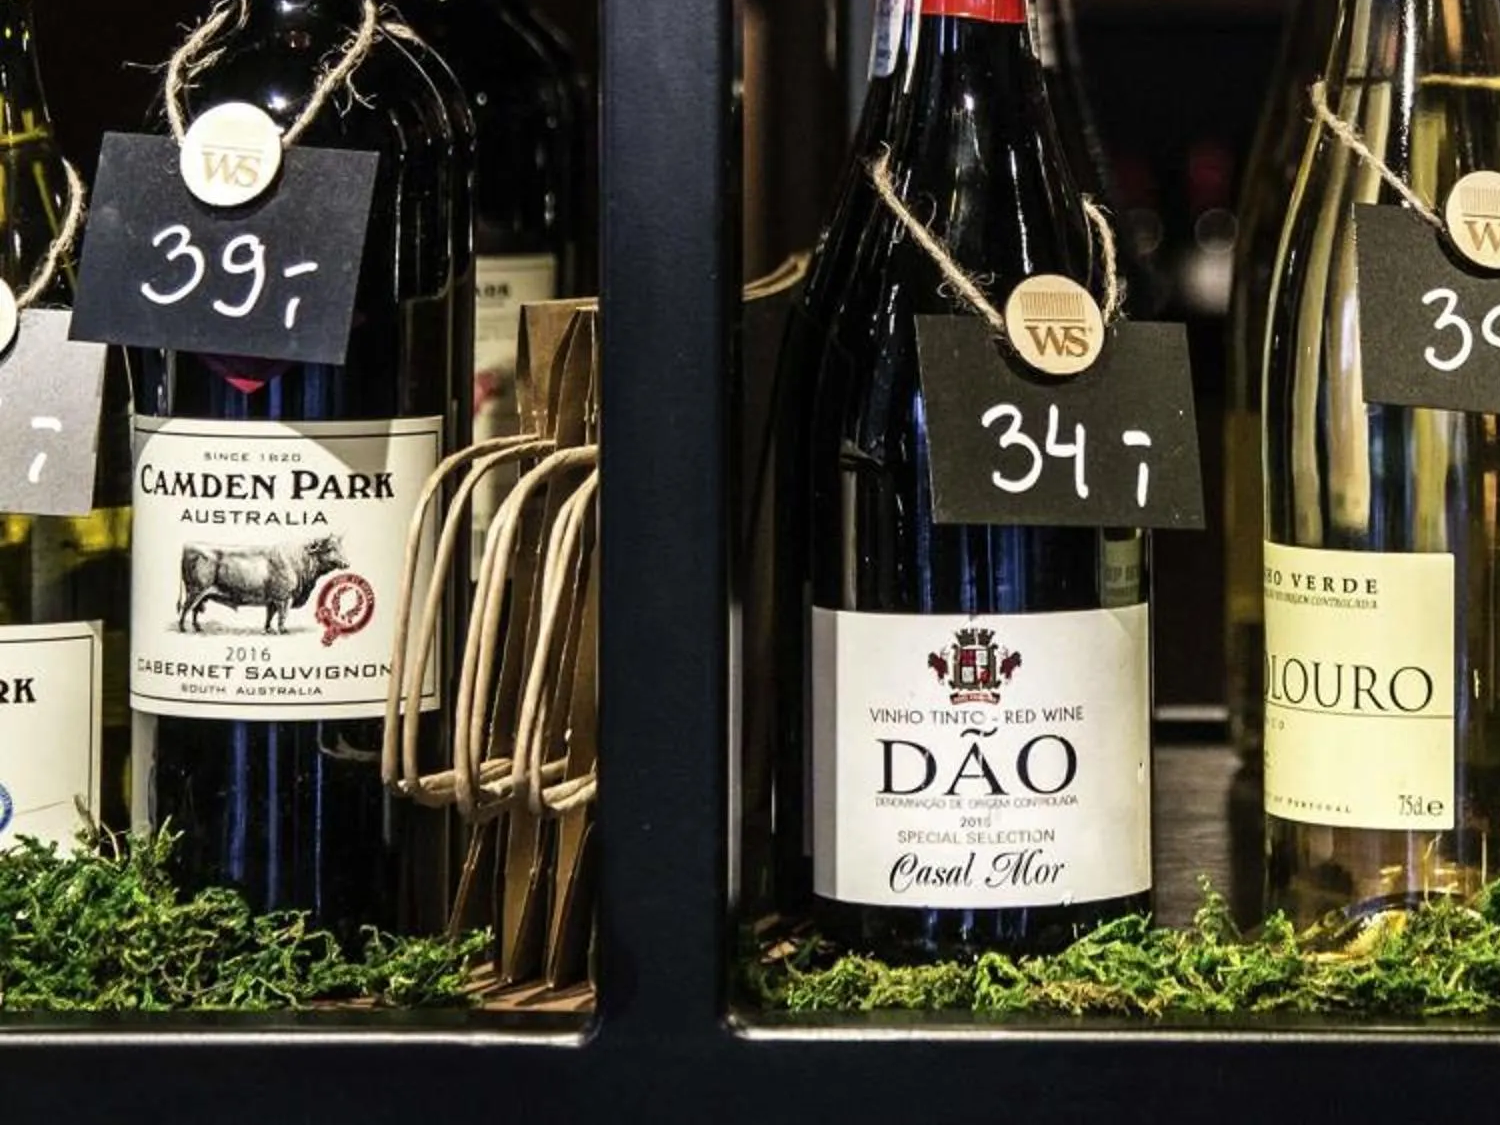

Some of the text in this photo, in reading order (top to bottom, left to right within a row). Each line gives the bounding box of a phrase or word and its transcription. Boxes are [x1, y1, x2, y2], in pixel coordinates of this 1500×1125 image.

[203, 452, 302, 462] SINCE 1820
[140, 464, 395, 500] CAMDEN PARK
[180, 509, 328, 525] AUSTRALIA
[1291, 573, 1378, 594] VERDE
[225, 647, 271, 662] 2016
[138, 658, 392, 680] CABERNET SAUVIGNON
[181, 682, 322, 696] SOUTH AUSTRALIA
[870, 708, 924, 724] VINHO
[931, 709, 986, 725] TINTO
[1005, 708, 1036, 724] RED
[1041, 706, 1084, 722] WINE
[875, 727, 1078, 796] DÃO
[897, 828, 1055, 844] SPECIAL SELECTION
[889, 848, 1065, 894] Casal Mor
